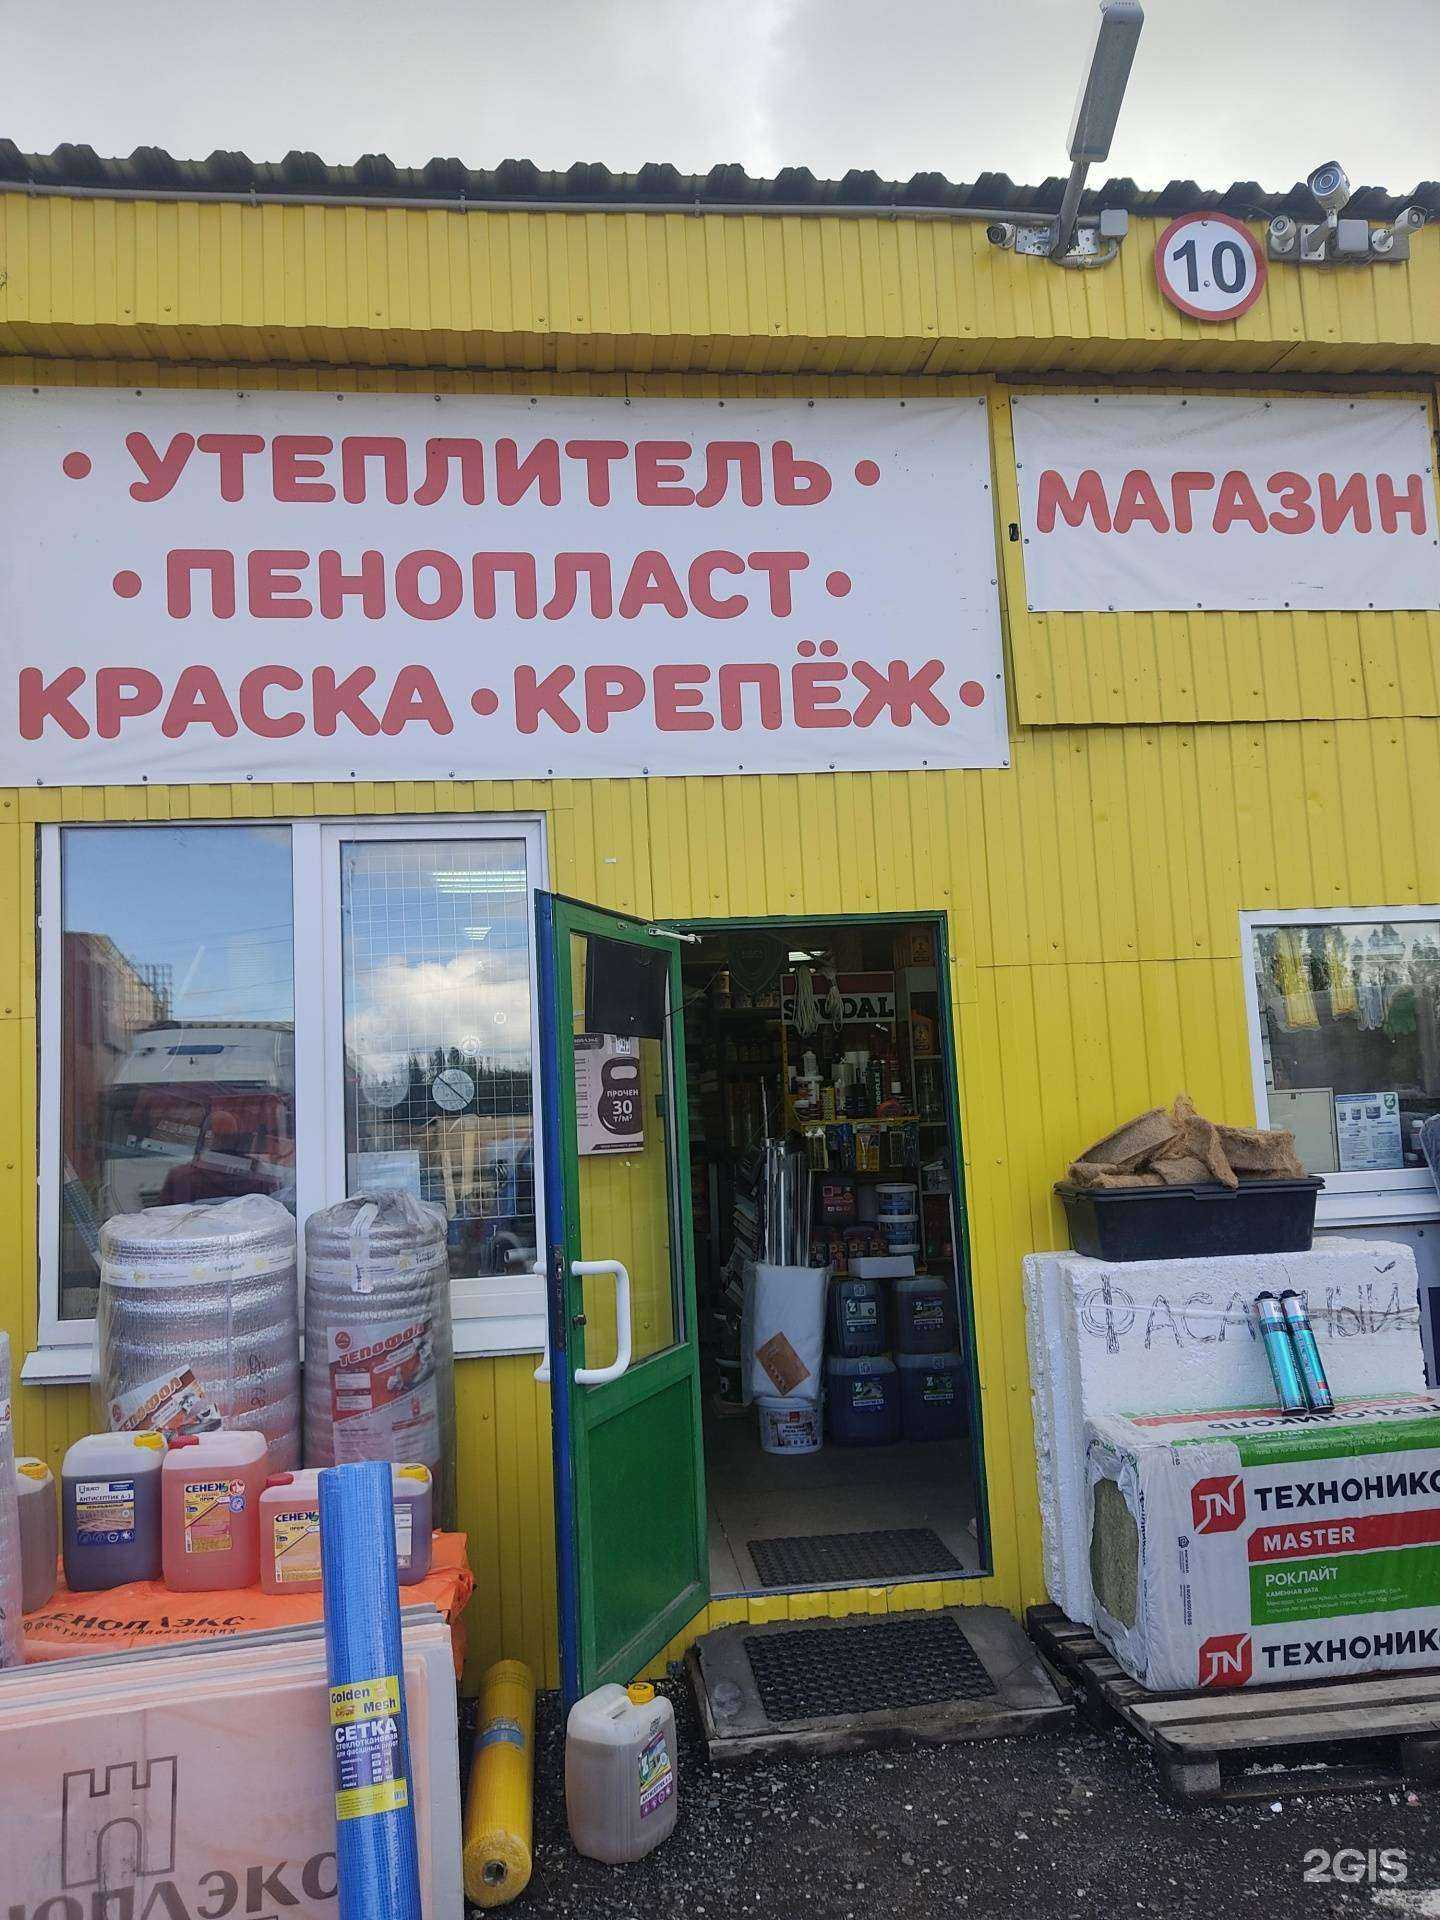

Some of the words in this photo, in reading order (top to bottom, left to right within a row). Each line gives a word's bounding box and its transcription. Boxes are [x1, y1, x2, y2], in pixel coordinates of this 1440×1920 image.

[1173, 239, 1247, 294] 10
[125, 431, 832, 508] УТЕПЛИТЕЛЬ
[1036, 469, 1427, 535] МАГАЗИН
[165, 548, 811, 621] ПЕНОПЛАСТ
[18, 664, 455, 741] КРАСКА
[514, 639, 951, 735] КРЕПЁЖ
[783, 996, 895, 1020] SUDAL
[606, 1088, 640, 1098] ПРОЧЕН
[612, 1100, 633, 1115] 30
[1080, 1261, 1401, 1354] ФАСАНЫЙ
[1263, 1525, 1356, 1553] MASTER
[1264, 1565, 1339, 1588] РОКЛАЙТ
[1262, 1628, 1440, 1668] ТЕХНОНИК
[331, 1687, 370, 1704] Golden
[363, 1697, 397, 1714] Mesh
[335, 1717, 398, 1743] СЕТКА
[9, 1851, 338, 1920] ОПЛЭКС
